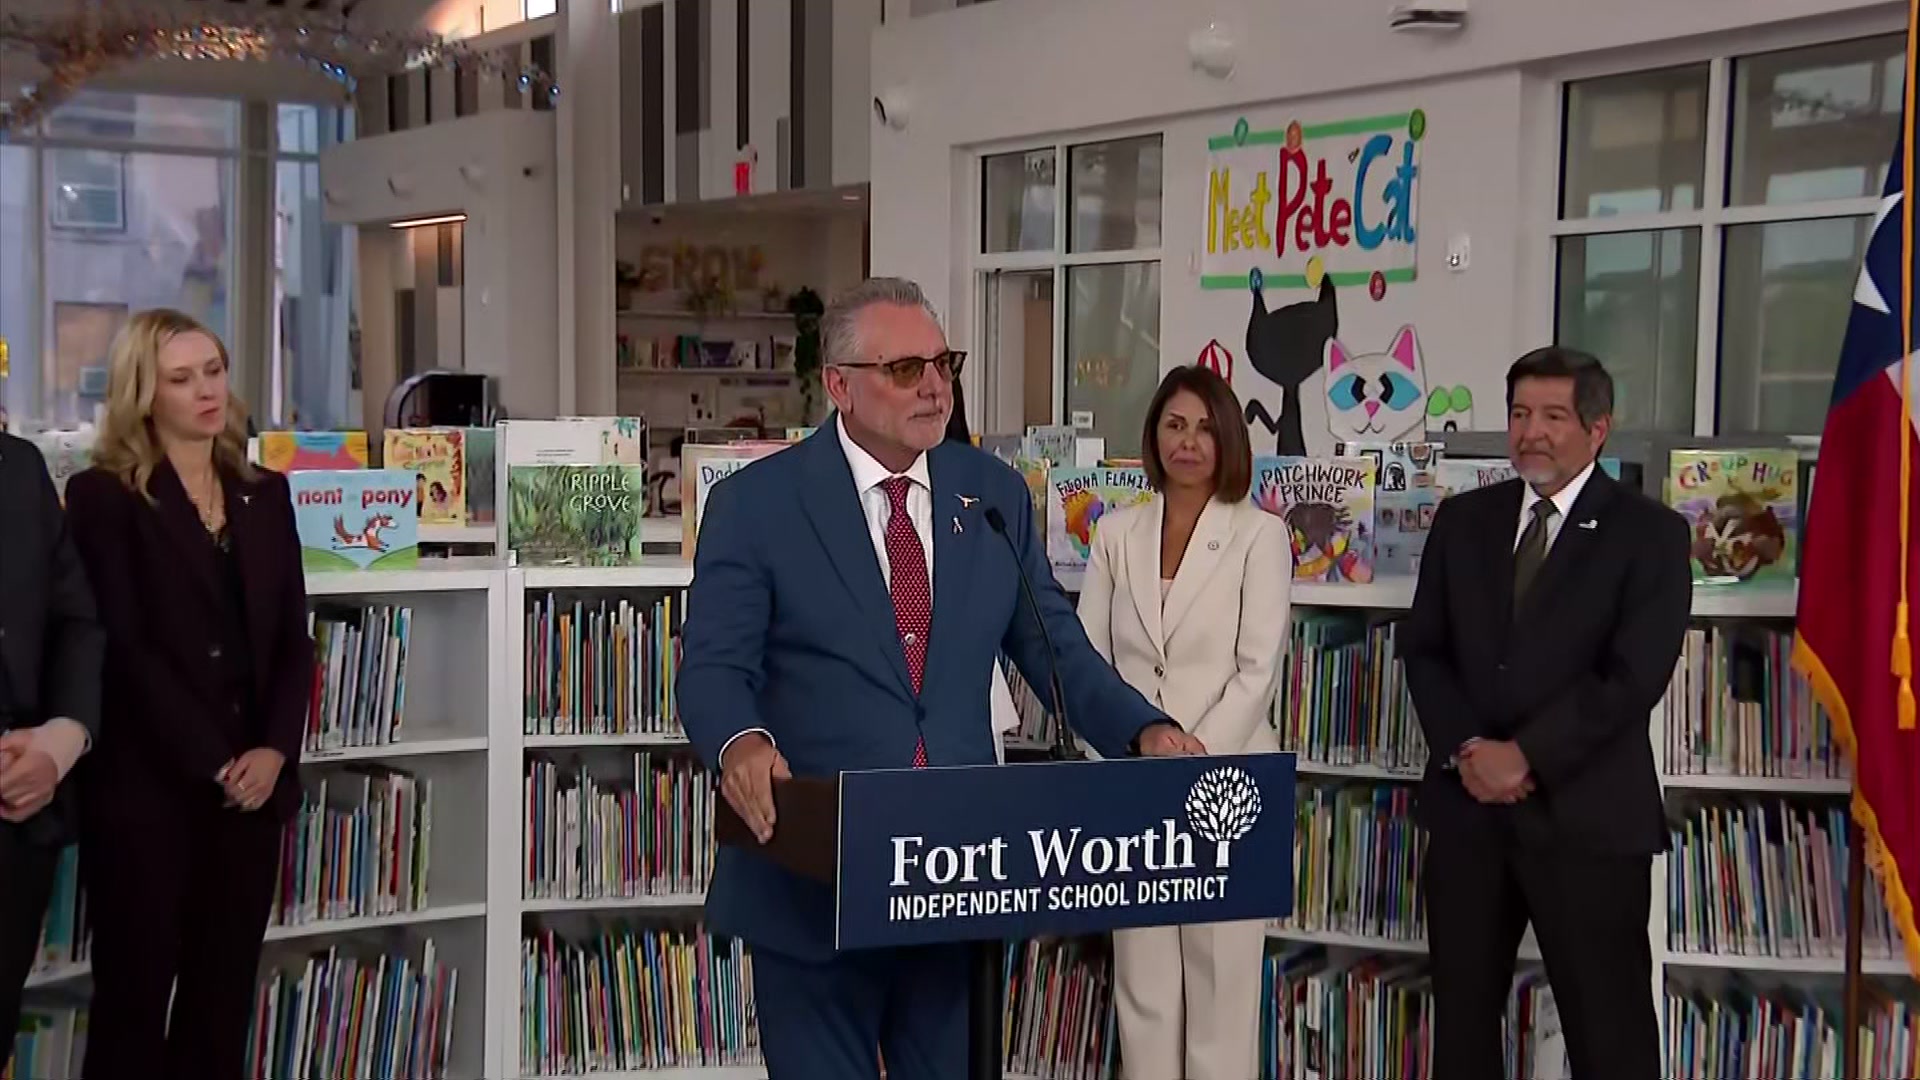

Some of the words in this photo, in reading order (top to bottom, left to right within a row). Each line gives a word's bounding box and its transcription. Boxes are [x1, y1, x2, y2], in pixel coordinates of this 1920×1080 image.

[1207, 166, 1272, 254] Meet
[1276, 146, 1352, 259] Pete
[1354, 134, 1418, 251] Cat
[570, 473, 630, 492] RIPPLE
[702, 462, 741, 485] Dad
[1261, 464, 1369, 489] PATCHWORK
[1679, 455, 1749, 490] GROUP
[1752, 461, 1794, 487] HUG
[297, 487, 343, 505] noni
[361, 487, 413, 509] pony
[570, 494, 631, 513] GROVE
[1281, 483, 1347, 504] PRINCE
[889, 836, 1008, 886] Fort
[1027, 818, 1196, 878] Worth
[889, 887, 1041, 922] INDEPENDENT
[1048, 881, 1130, 910] SCHOOL
[1138, 875, 1229, 904] DISTRICT
